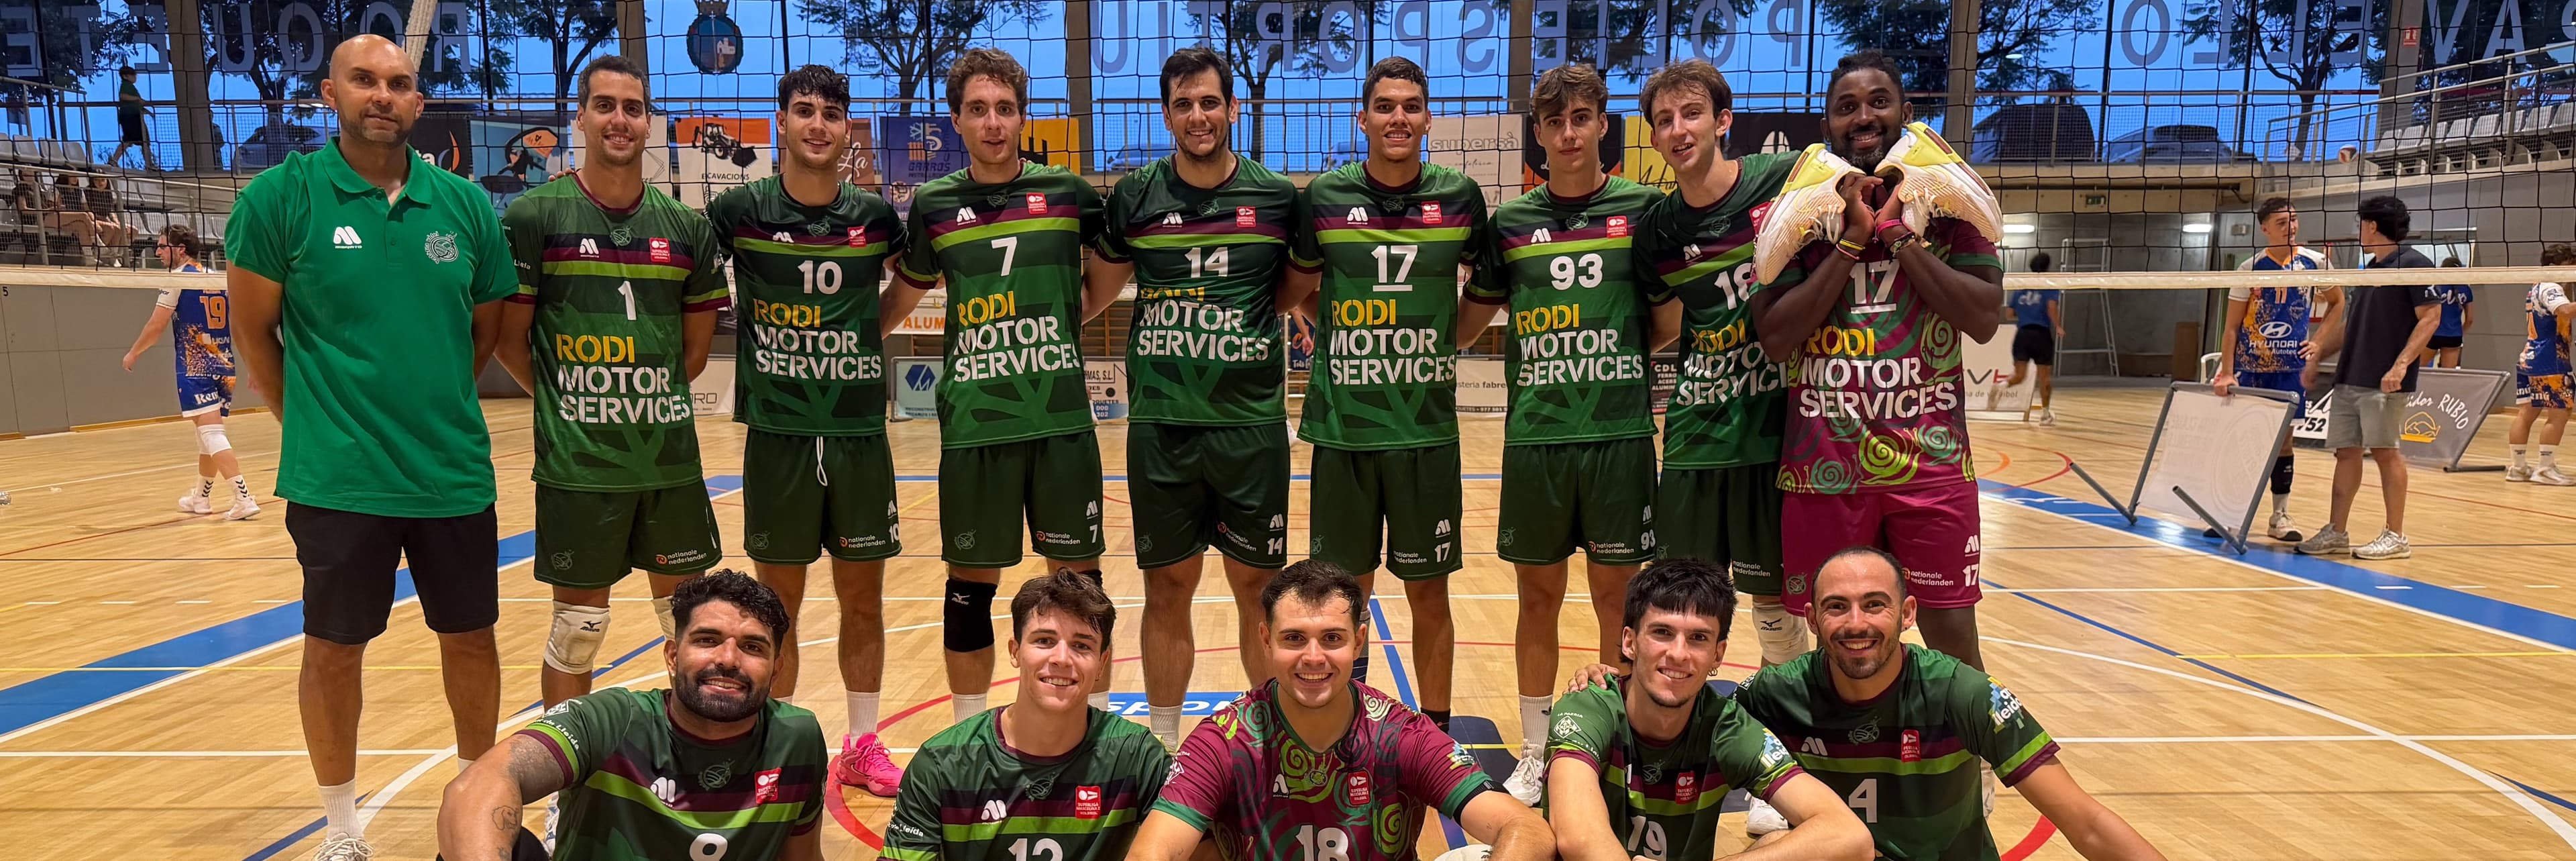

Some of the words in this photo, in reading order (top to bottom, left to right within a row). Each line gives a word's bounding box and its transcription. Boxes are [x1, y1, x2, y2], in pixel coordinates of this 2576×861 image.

[838, 142, 868, 172] La
[1430, 132, 1518, 155] supersà
[991, 236, 1018, 277] 7
[1185, 246, 1228, 278] 14
[1371, 245, 1418, 285] 17
[1550, 253, 1603, 290] 93
[798, 260, 843, 295] 10
[1849, 259, 1900, 304] 17
[199, 295, 226, 330] 19
[619, 281, 637, 321] 1
[753, 298, 820, 328] RODI
[957, 291, 1016, 327] RODI
[1140, 299, 1244, 333] MOTOR
[1331, 299, 1396, 326] RODI
[1516, 303, 1580, 335] RODI
[555, 334, 635, 363] RODI
[755, 324, 859, 354] MOTOR
[954, 315, 1060, 356] MOTOR
[1136, 330, 1271, 362] SERVICES
[1330, 328, 1438, 356] MOTOR
[1520, 329, 1618, 361] MOTOR
[1806, 325, 1875, 357] RODI
[2249, 340, 2298, 348] HYUNDAI
[755, 349, 882, 379] SERVICES
[955, 342, 1080, 383] SERVICES
[1330, 354, 1456, 386] SERVICES
[1516, 354, 1644, 387] SERVICES
[1654, 364, 1677, 372] CDL
[1684, 342, 1769, 379] MOTO
[1801, 357, 1924, 389] MOTOR
[559, 364, 669, 394] MOTOR
[558, 395, 690, 424] SERVICES
[1799, 382, 1957, 419] SERVICES
[2437, 393, 2469, 429] RUBIO
[849, 540, 885, 548] nederlanden
[889, 523, 900, 544] 10
[1089, 524, 1098, 544] 7
[1267, 537, 1283, 556] 14
[1641, 529, 1656, 550] 93
[667, 549, 697, 560] nationale
[1434, 541, 1451, 563] 17
[1911, 570, 1942, 579] nationale
[1962, 563, 1979, 587] 17
[1848, 778, 1878, 823] 4
[1296, 824, 1349, 861] 18
[1627, 815, 1667, 861] 19
